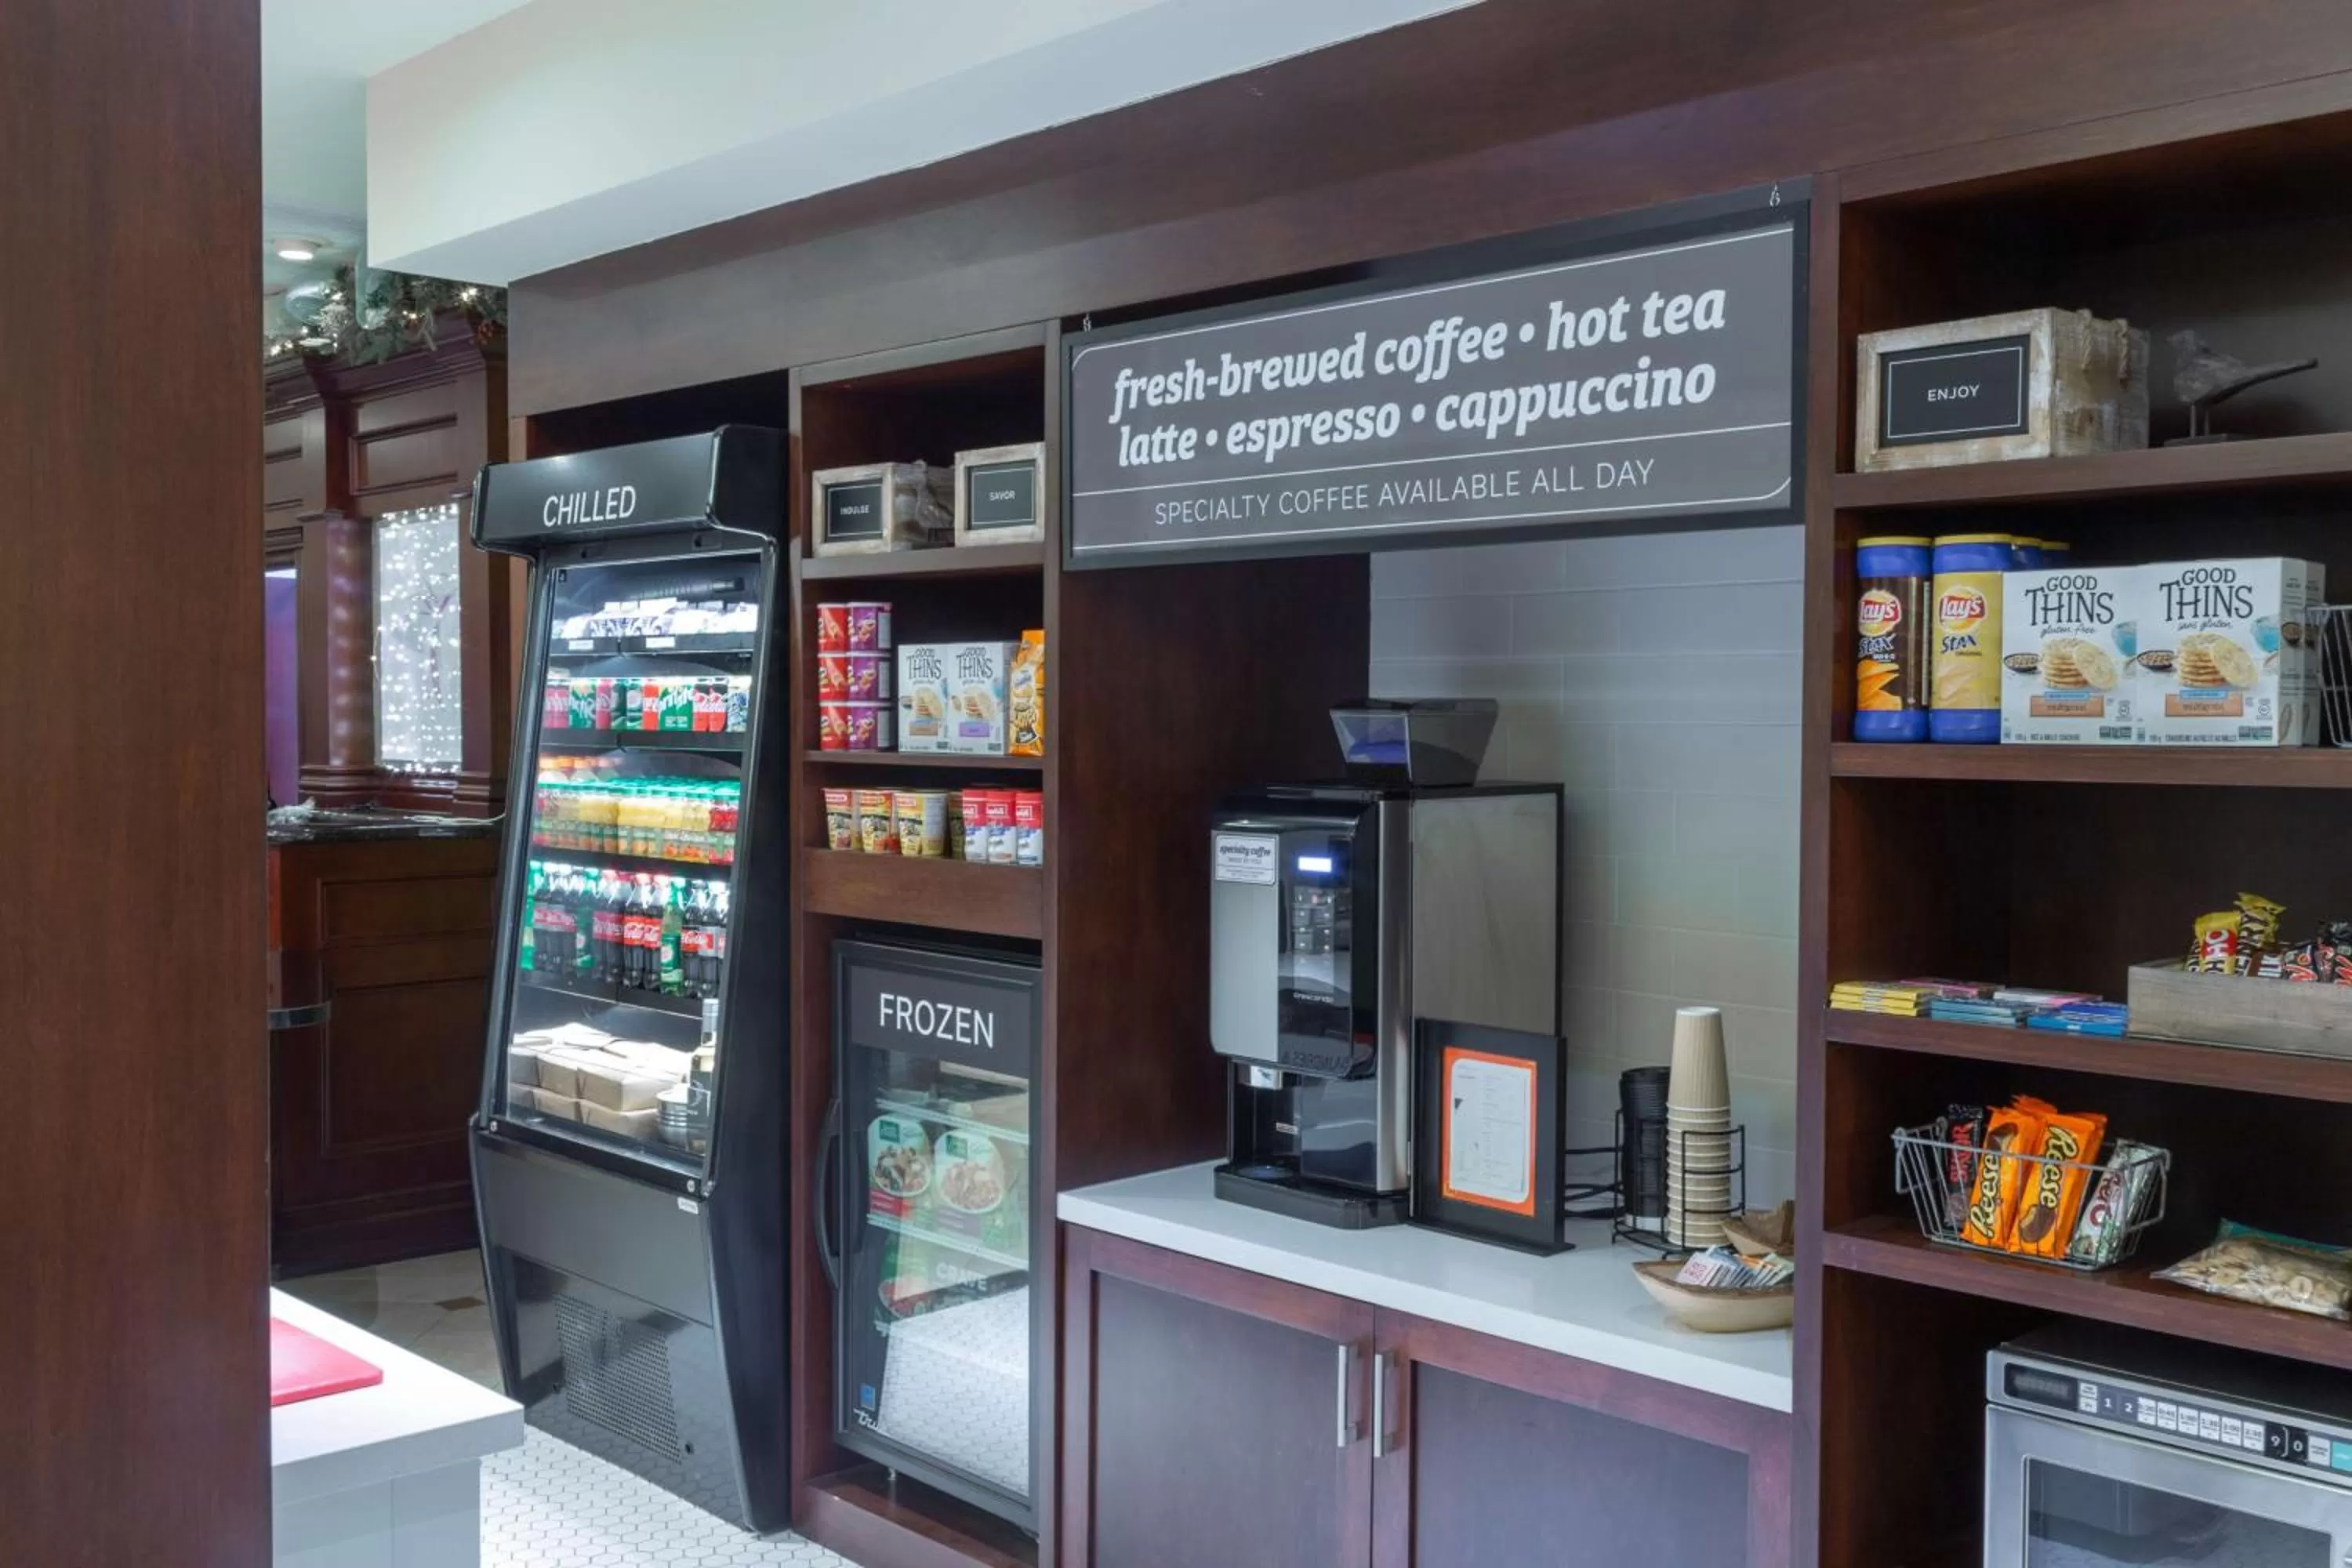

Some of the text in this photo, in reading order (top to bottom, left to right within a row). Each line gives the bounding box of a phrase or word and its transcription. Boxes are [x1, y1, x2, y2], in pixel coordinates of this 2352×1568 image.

[1109, 289, 1726, 423] fresh-brewed coffee hot tea
[1928, 384, 1980, 401] ENJOY
[1119, 355, 1716, 467] latte espresso cappuccino
[989, 489, 1017, 502] SAVOR
[1154, 458, 1655, 525] SPECIALTY COFFEE AVAILABLE ALL DAY
[543, 485, 636, 528] CHILLED
[2046, 575, 2098, 592] GOOD
[2182, 567, 2236, 586] GOOD
[1940, 594, 1984, 619] Lay's
[2024, 586, 2115, 626] THINS
[2159, 579, 2253, 622] THINS
[906, 655, 942, 680] THINS
[956, 655, 994, 679] THINS
[880, 993, 994, 1050] FROZEN
[2105, 1397, 2112, 1408] 1
[2123, 1402, 2133, 1414] 2
